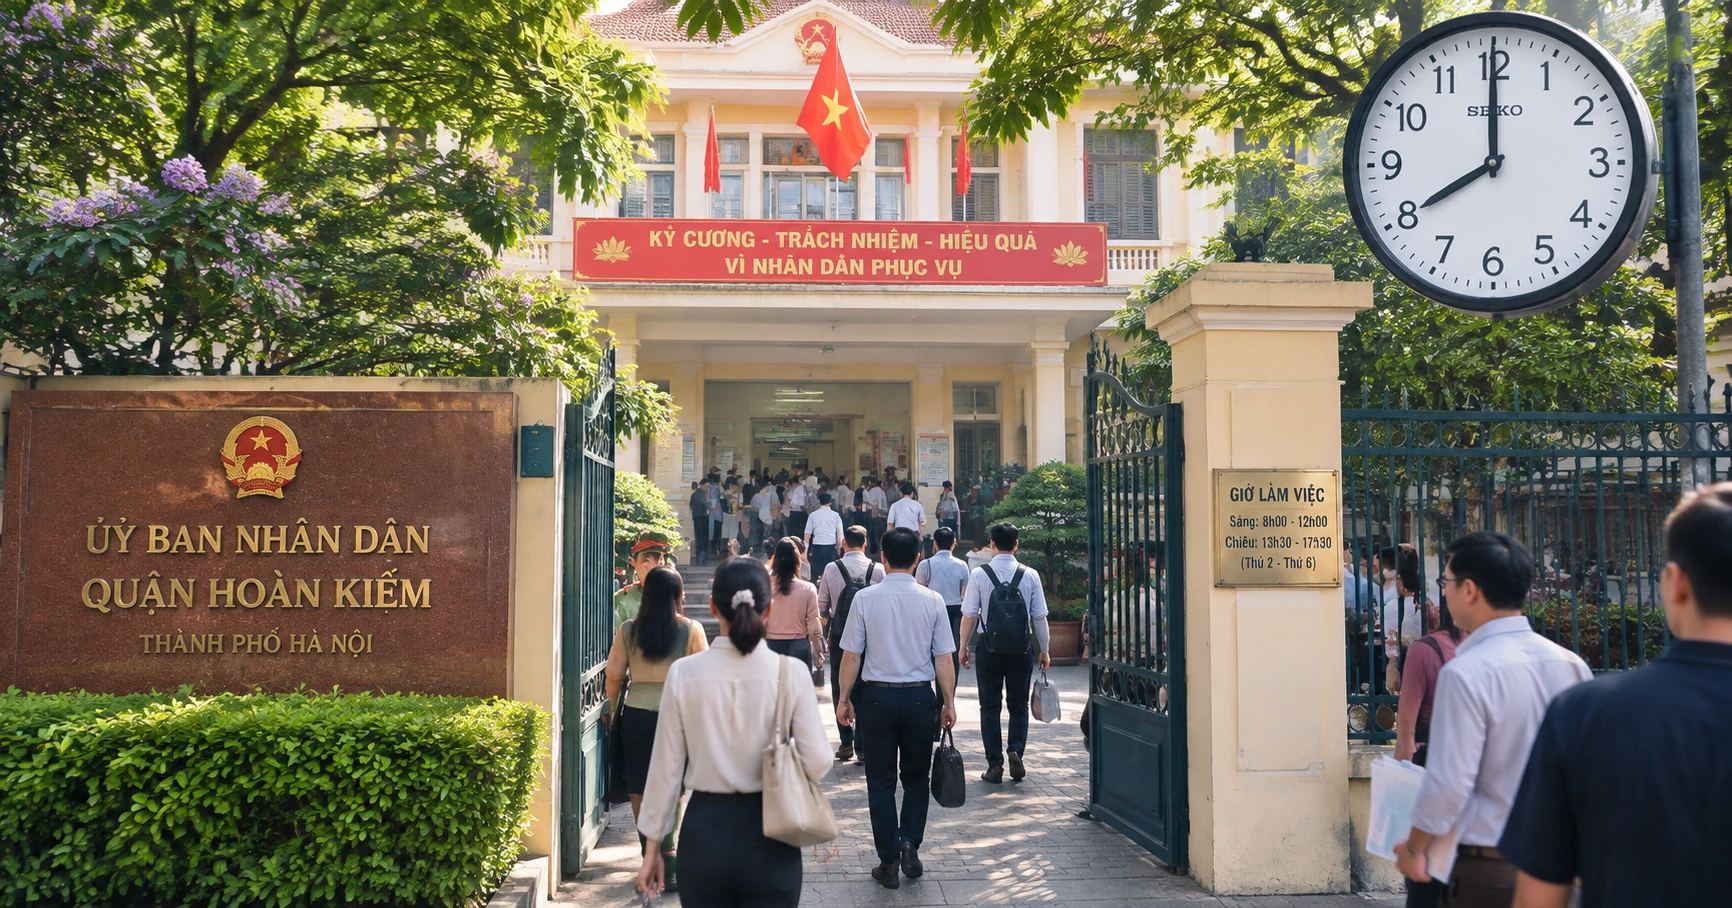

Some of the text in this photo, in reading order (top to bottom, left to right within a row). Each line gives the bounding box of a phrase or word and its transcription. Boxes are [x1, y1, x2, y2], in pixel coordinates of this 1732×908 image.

[1432, 65, 1455, 94] 11
[1478, 50, 1510, 80] 12
[1540, 61, 1550, 91] 1
[1396, 103, 1427, 132] 10
[1467, 105, 1523, 117] SEKO
[1573, 96, 1594, 126] 2
[1381, 150, 1402, 180] 9
[1588, 147, 1610, 178] 3
[1397, 200, 1419, 229] 8
[1569, 200, 1592, 228] 4
[683, 229, 755, 248] CƯƠNG
[851, 227, 918, 254] NHIỆM
[939, 225, 988, 254] HIỆU
[1435, 235, 1455, 263] 7
[1534, 235, 1555, 264] 5
[871, 259, 928, 280] PHỤC
[934, 259, 962, 280] VỤ
[1482, 246, 1504, 276] 6
[1259, 481, 1289, 502] LÀM
[1293, 483, 1325, 506] VIỆC
[146, 525, 224, 554] BAN
[235, 517, 342, 554] NHÂN
[353, 517, 431, 554] DÂN
[1262, 515, 1287, 528] 8h00
[1298, 515, 1328, 528] 12h00
[1262, 536, 1292, 549] 13h30
[1267, 557, 1273, 569] 2
[1305, 556, 1316, 571] 6)
[81, 569, 196, 616] QUẬN
[207, 569, 321, 608] HOÀN
[139, 626, 373, 658] THÀNH PHỐ HÀ NỘI
